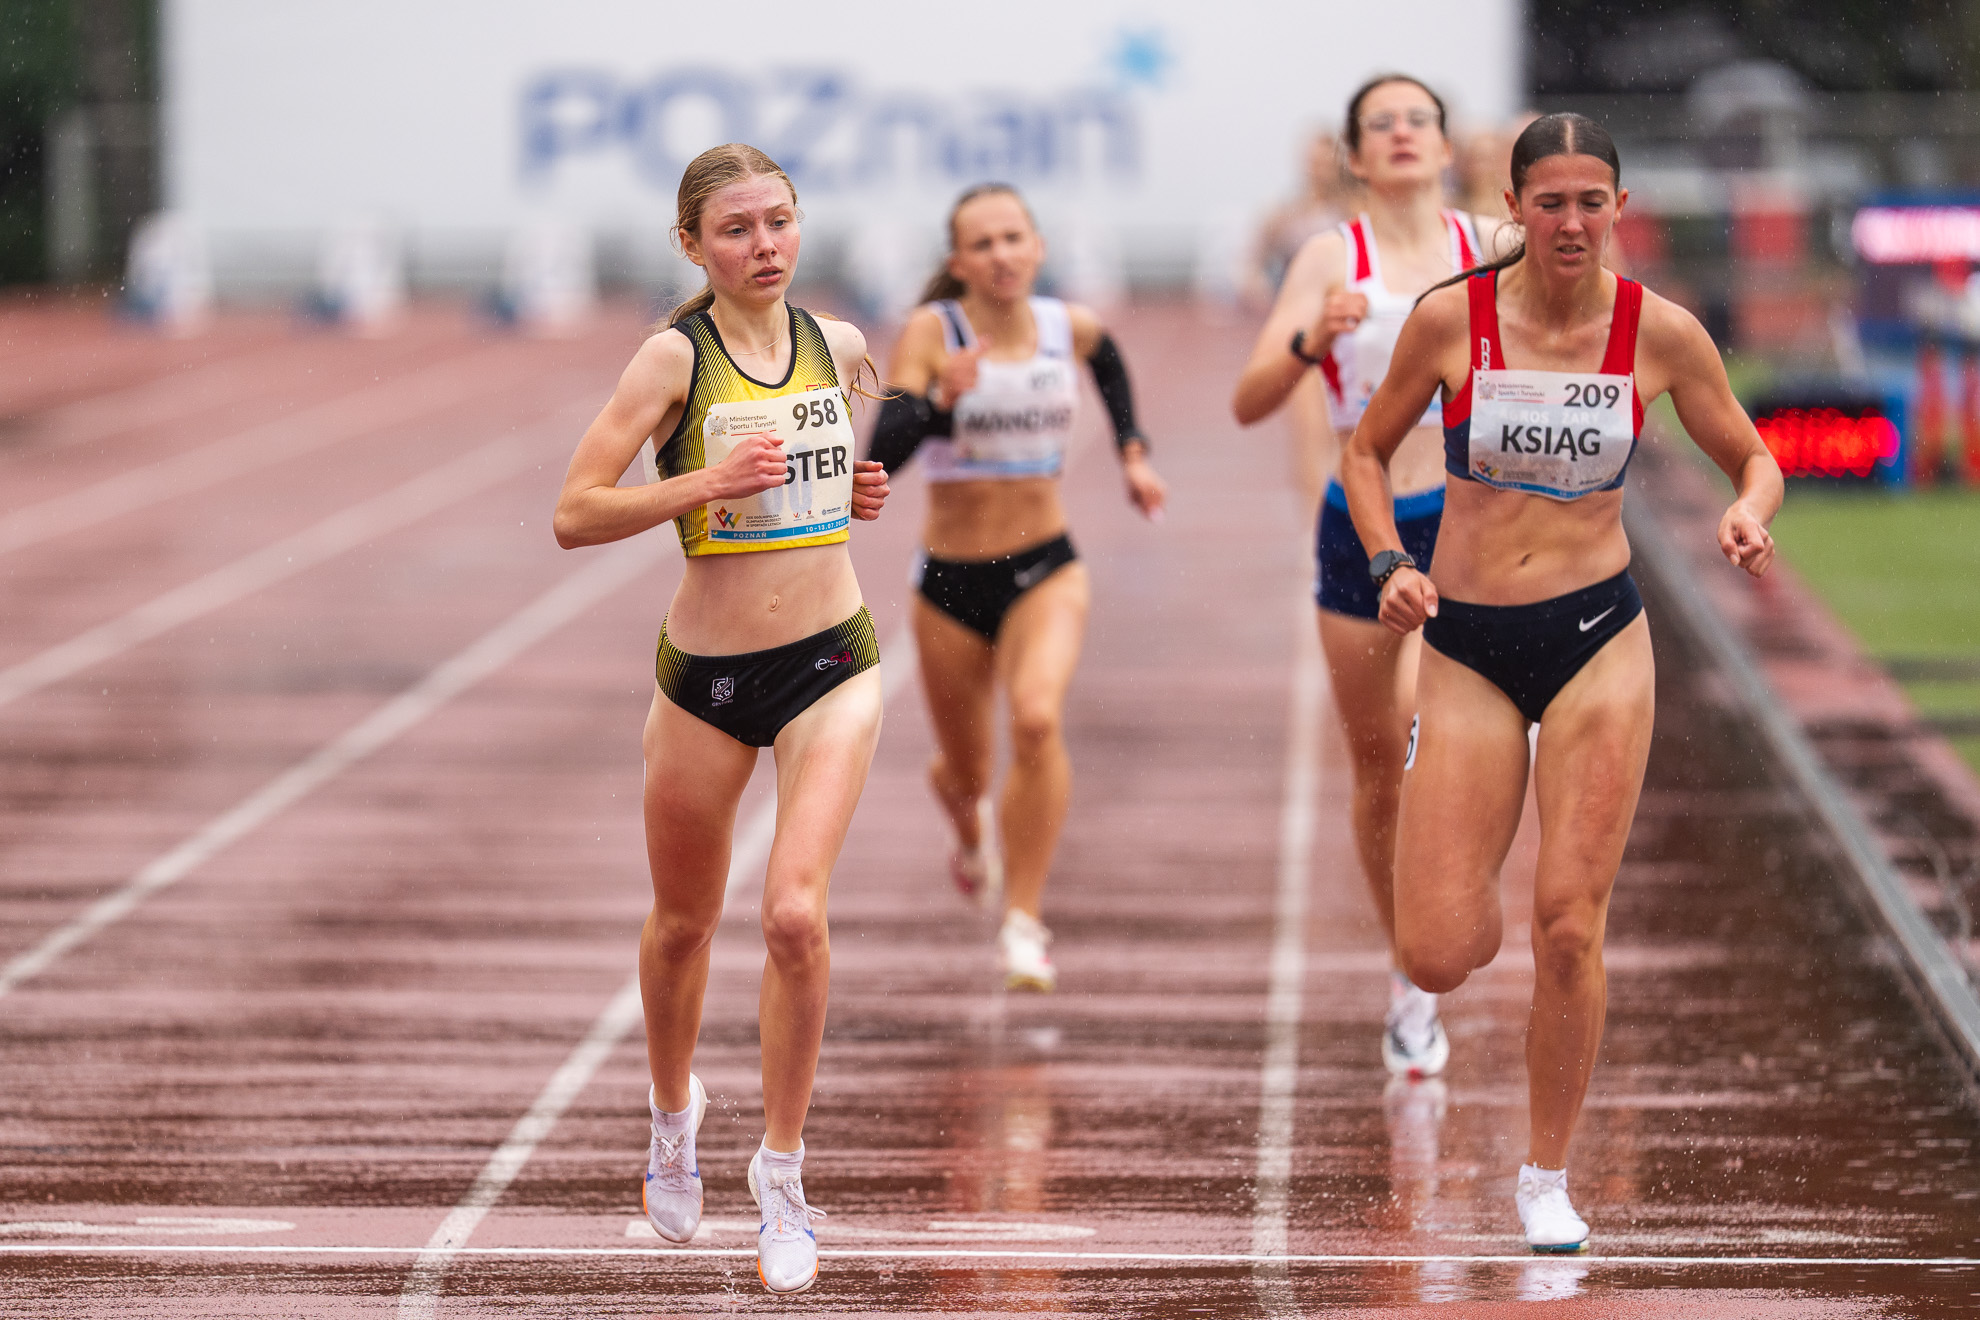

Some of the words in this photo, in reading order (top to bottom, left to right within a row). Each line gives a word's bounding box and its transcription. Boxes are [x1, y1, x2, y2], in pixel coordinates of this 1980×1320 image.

[1563, 382, 1620, 409] 209
[729, 414, 768, 423] Ministerstwo
[729, 423, 750, 431] Sportu
[754, 419, 777, 428] Turystyki
[792, 398, 838, 431] 958
[1501, 424, 1601, 461] KSIĄG
[784, 445, 848, 485] STER
[733, 531, 767, 539] POZNAŃ
